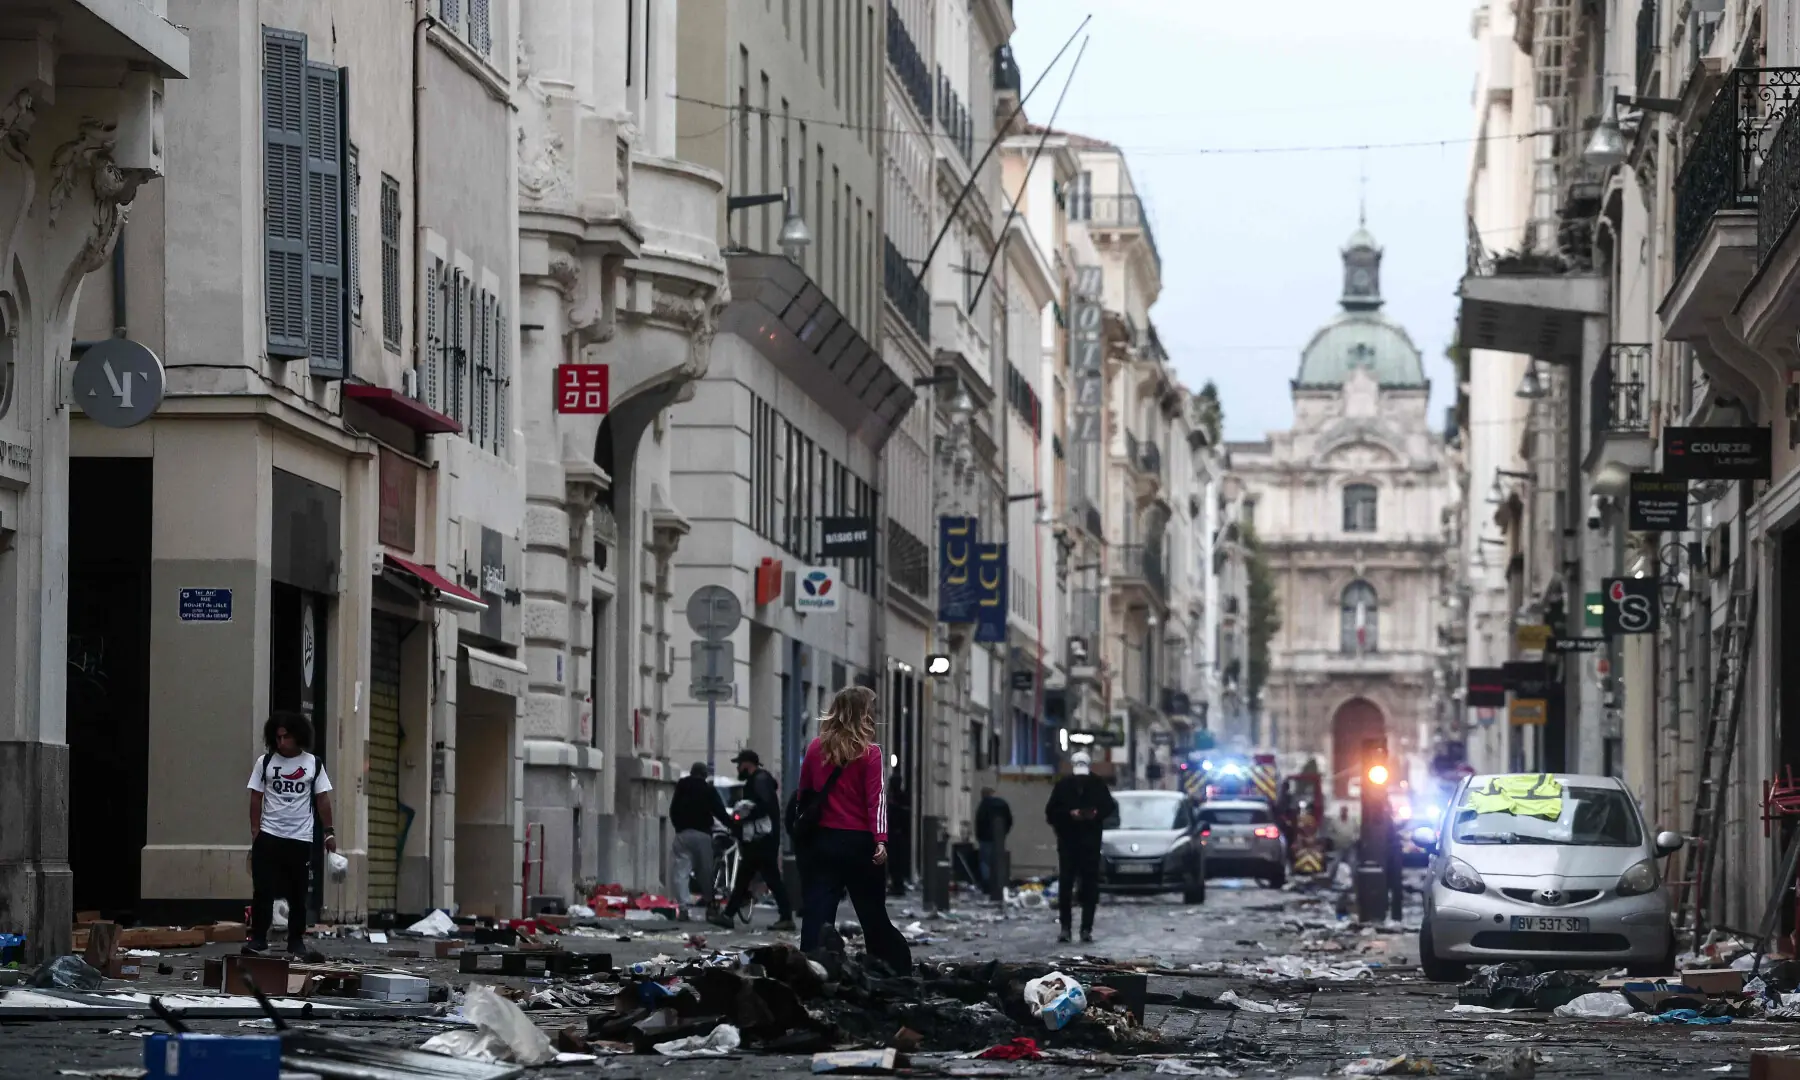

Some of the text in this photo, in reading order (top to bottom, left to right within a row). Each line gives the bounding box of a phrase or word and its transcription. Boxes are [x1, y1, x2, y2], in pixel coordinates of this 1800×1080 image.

[1079, 269, 1101, 438] HOTEL
[947, 519, 968, 584] LCL
[980, 544, 999, 606] LCL
[272, 766, 282, 779] I
[272, 780, 306, 794] QRO
